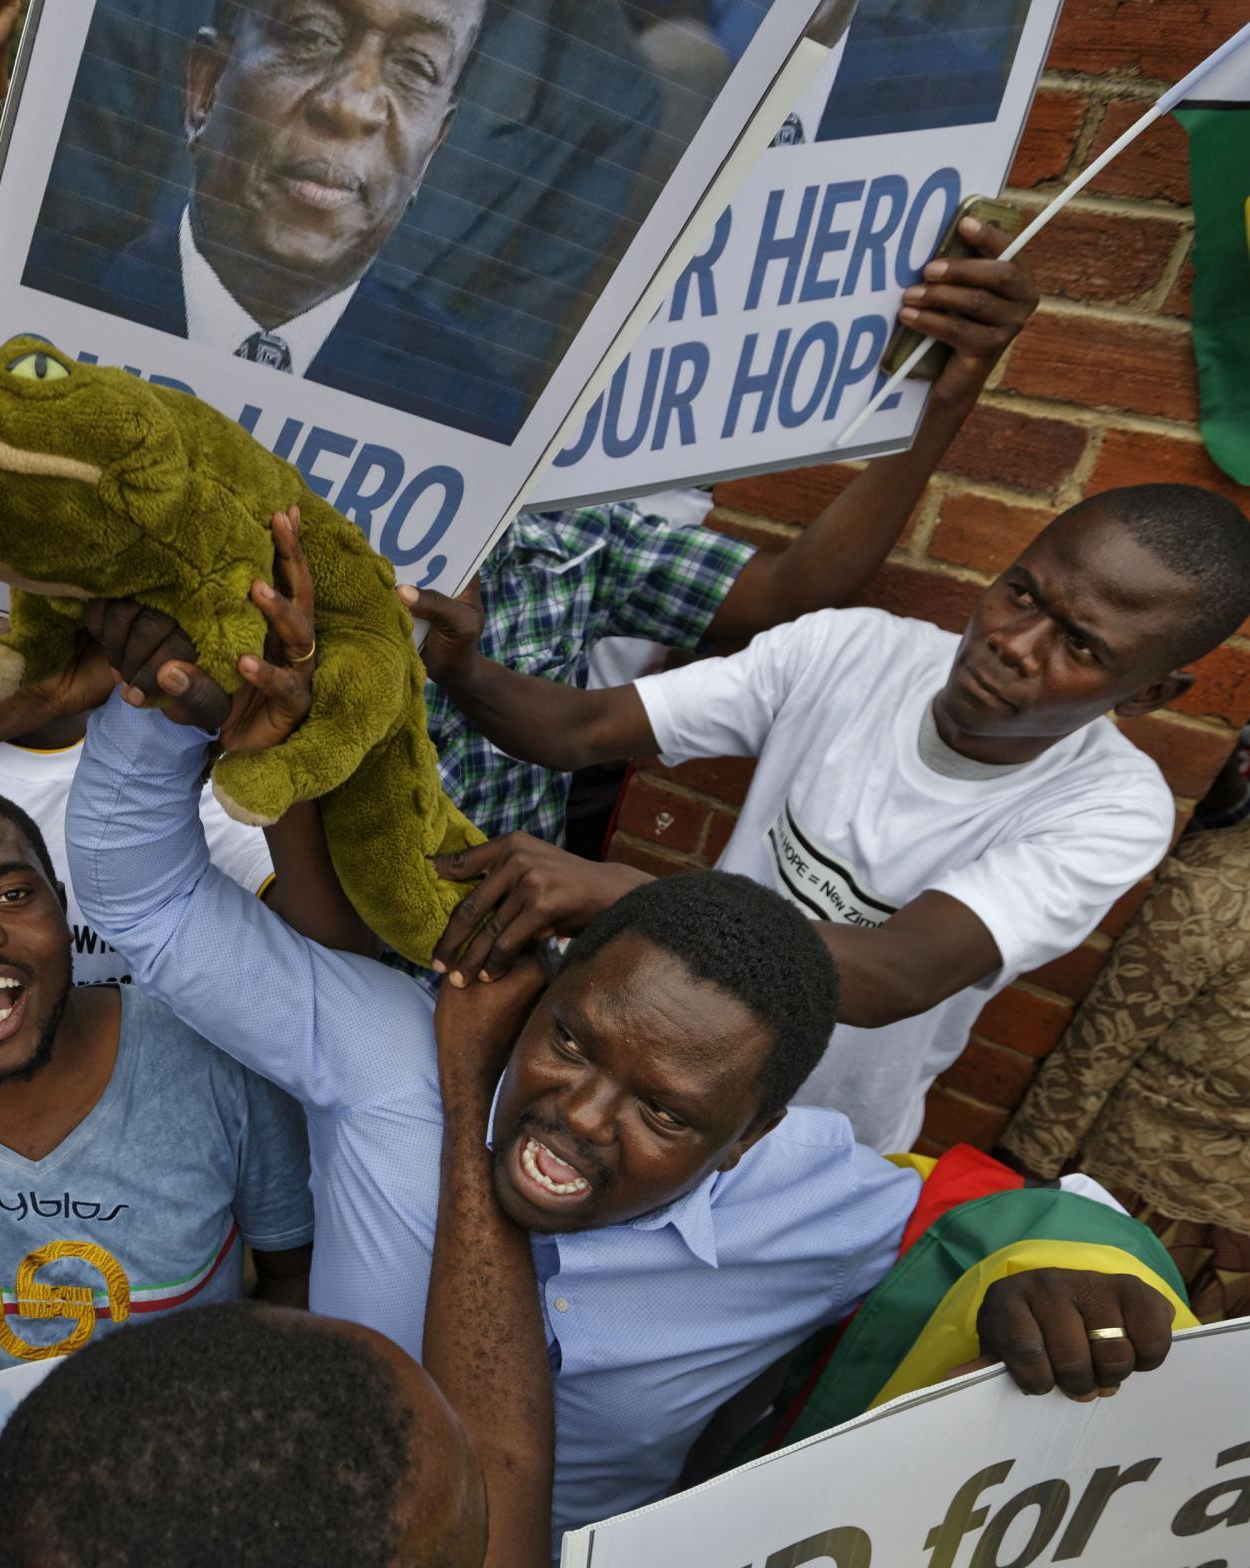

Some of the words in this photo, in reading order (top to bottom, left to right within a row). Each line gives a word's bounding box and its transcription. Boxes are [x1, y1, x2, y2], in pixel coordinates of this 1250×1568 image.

[781, 836, 810, 878] HOPE
[819, 880, 846, 911] New
[844, 906, 884, 929] Zim
[922, 1457, 1162, 1568] for
